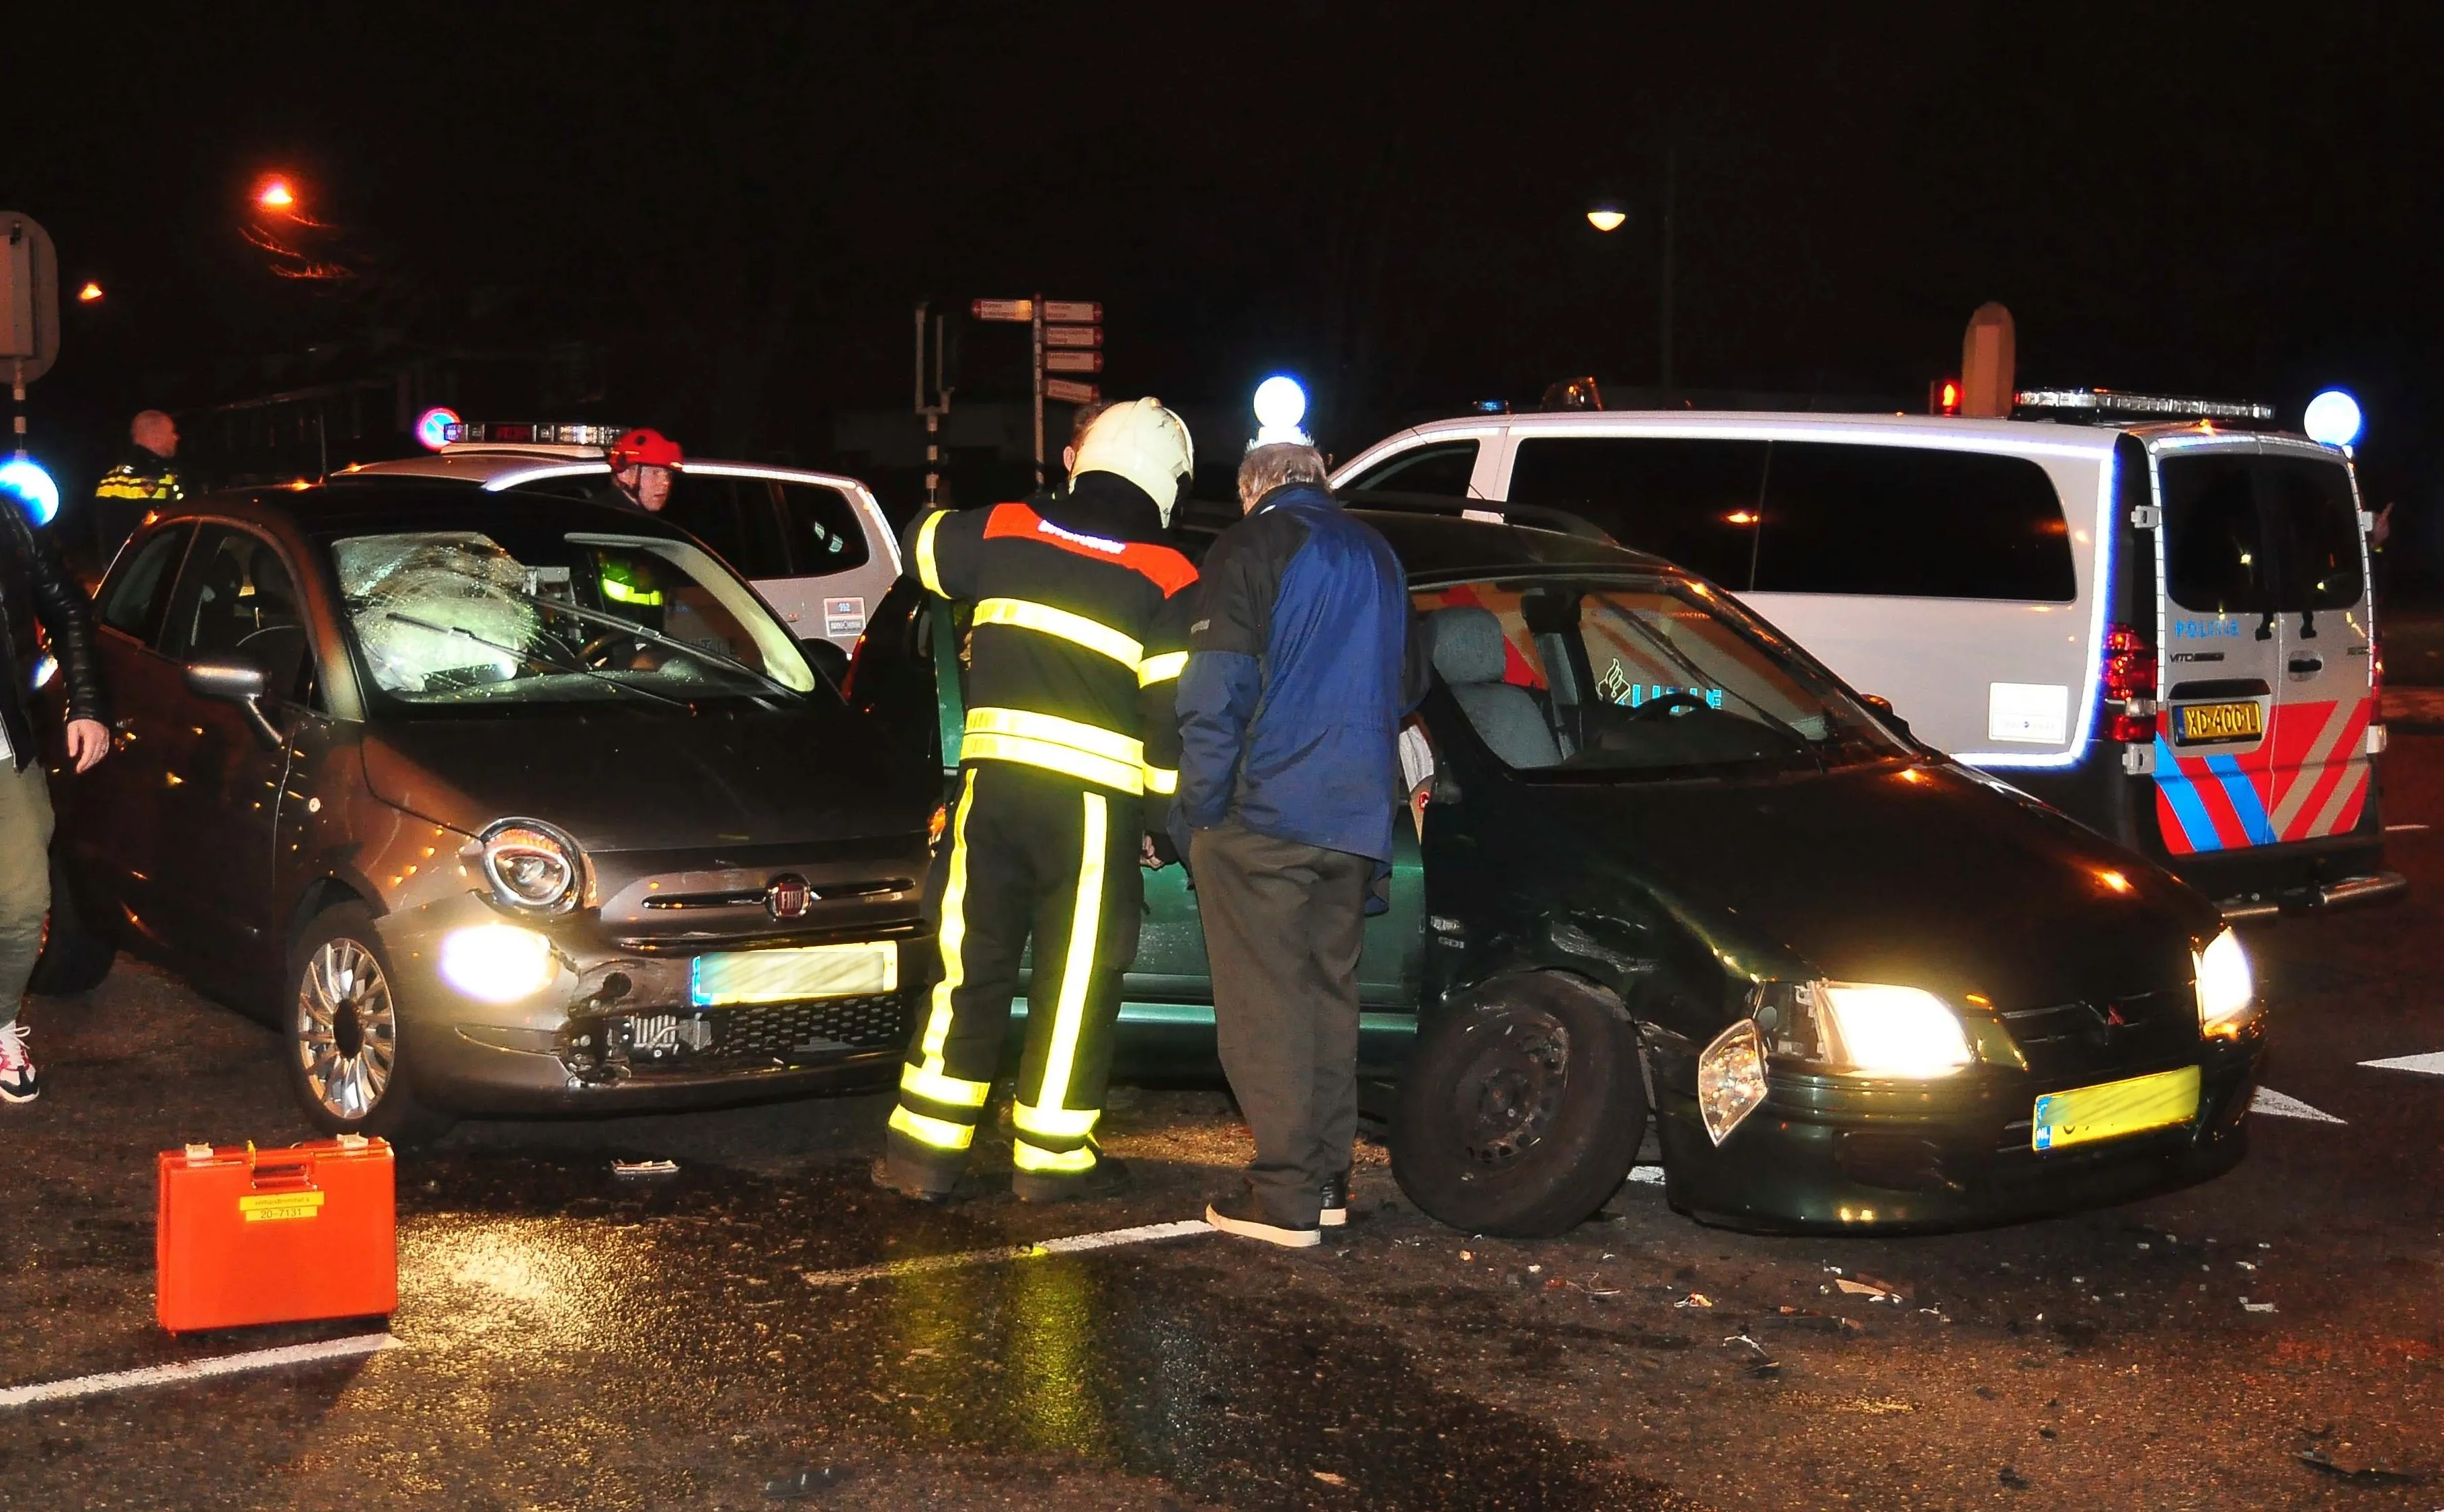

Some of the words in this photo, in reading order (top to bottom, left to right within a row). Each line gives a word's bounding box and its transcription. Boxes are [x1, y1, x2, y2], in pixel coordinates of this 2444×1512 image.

[2174, 619, 2240, 638] POLITIE
[2170, 653, 2193, 663] VITO
[781, 890, 803, 909] FIAT
[261, 1207, 302, 1219] 20-7131
